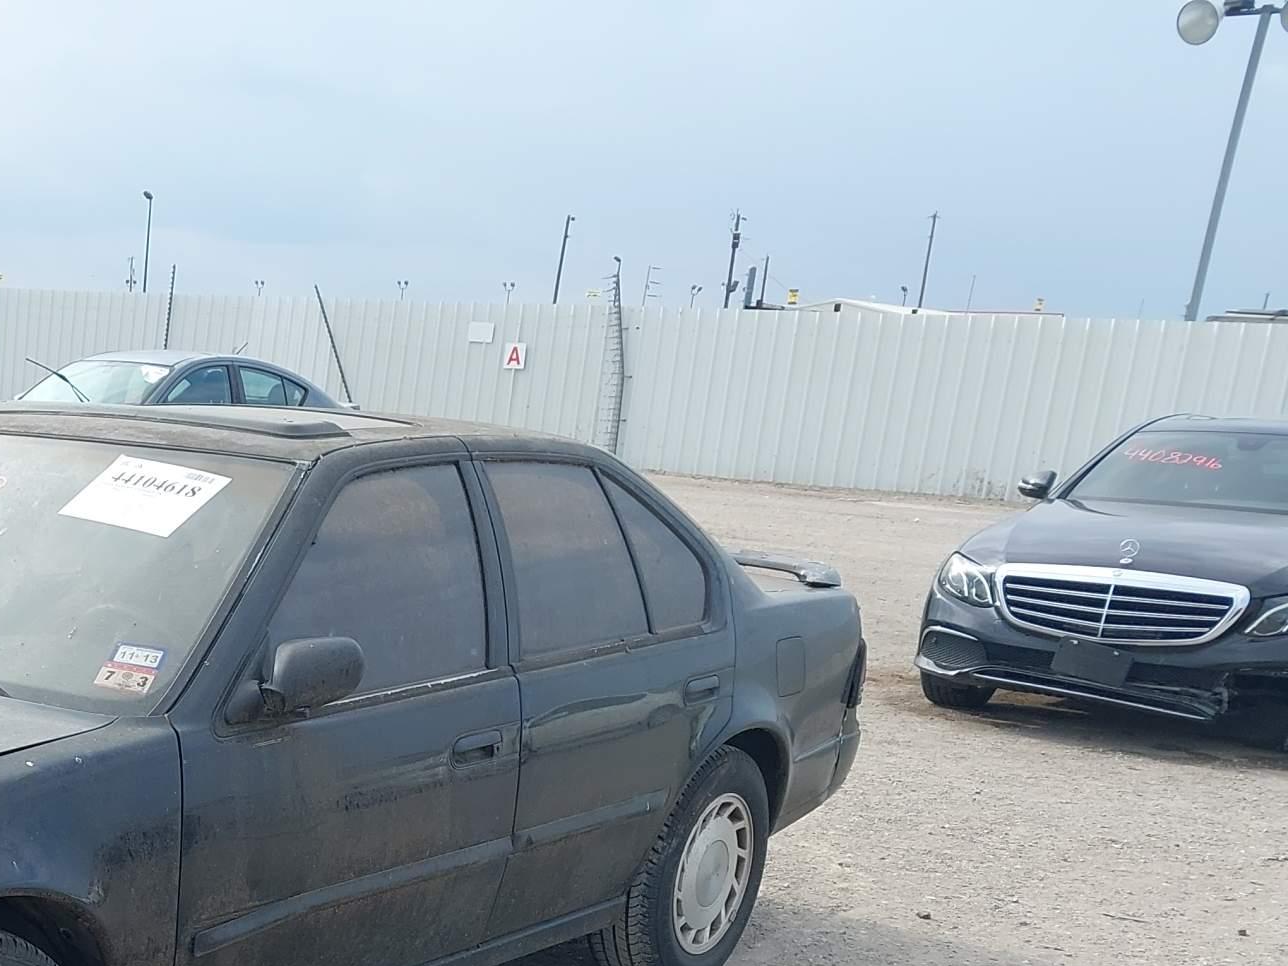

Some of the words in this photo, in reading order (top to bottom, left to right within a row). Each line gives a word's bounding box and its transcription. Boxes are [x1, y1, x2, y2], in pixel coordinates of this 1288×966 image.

[506, 346, 520, 365] A
[111, 471, 202, 498] 44104618
[120, 650, 136, 660] 11
[143, 653, 159, 664] 13
[104, 671, 116, 681] 7
